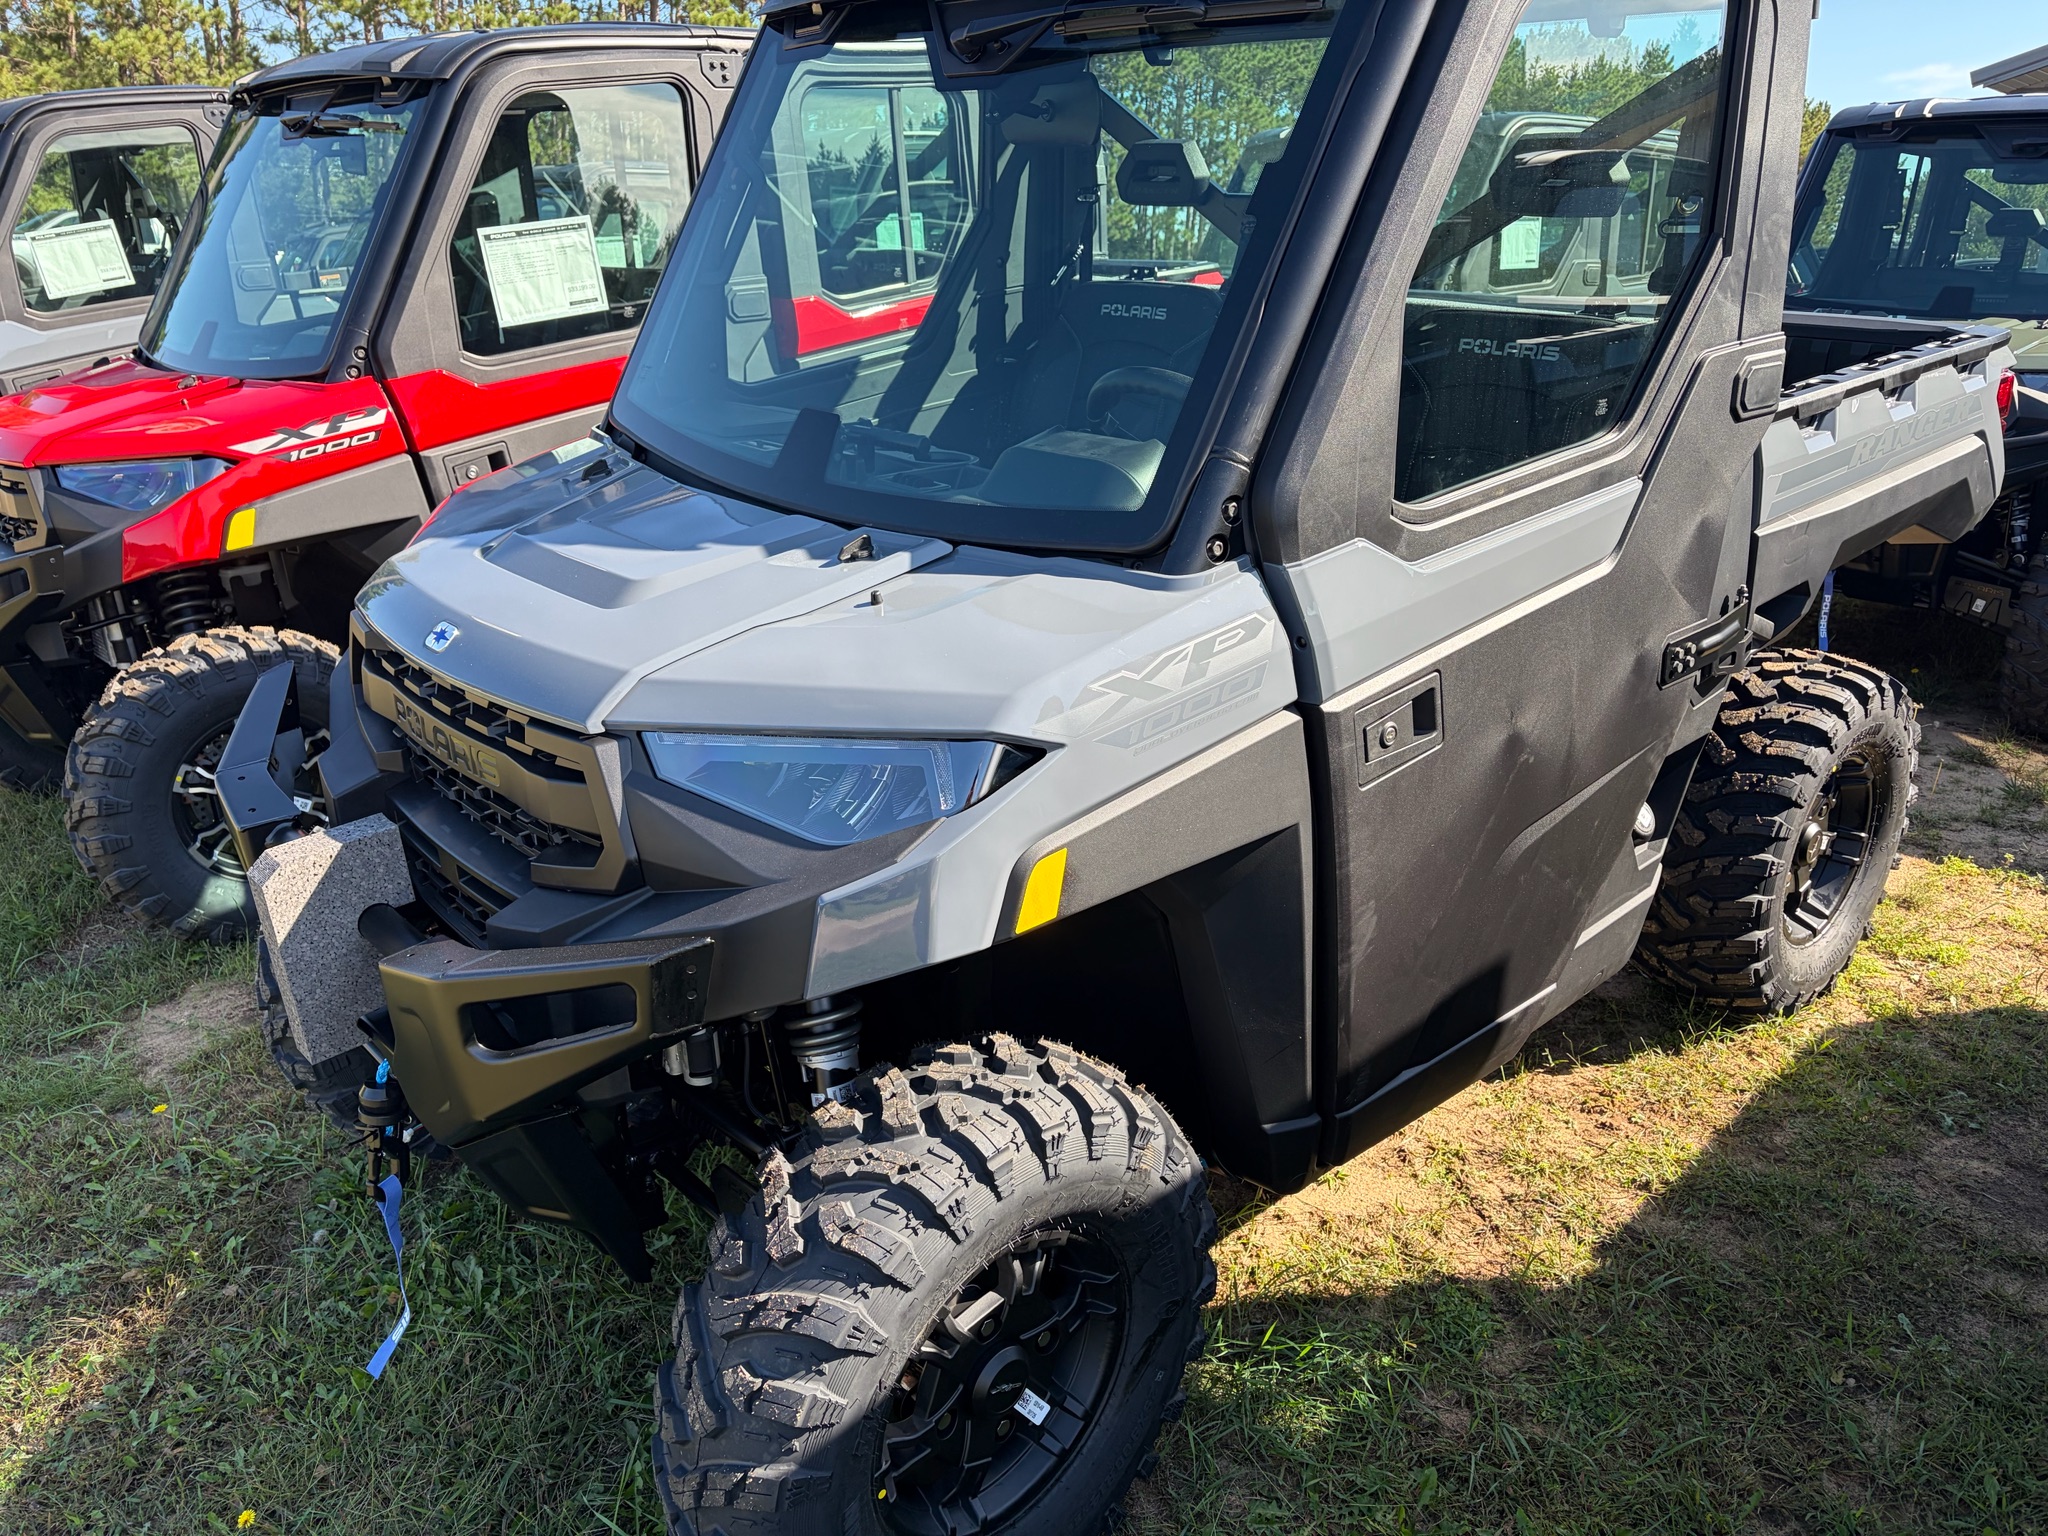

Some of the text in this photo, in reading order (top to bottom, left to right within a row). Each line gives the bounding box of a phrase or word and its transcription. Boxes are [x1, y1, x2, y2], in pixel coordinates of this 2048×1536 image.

[1101, 304, 1167, 320] POLARIS
[1458, 338, 1560, 361] POLARIS
[258, 405, 382, 452] XP
[289, 431, 375, 462] 1000
[1848, 395, 1974, 469] RANGER
[1820, 594, 1832, 638] POLARIS
[1080, 613, 1267, 735] XP
[1129, 667, 1258, 746] 1000
[393, 693, 500, 787] POLARIS
